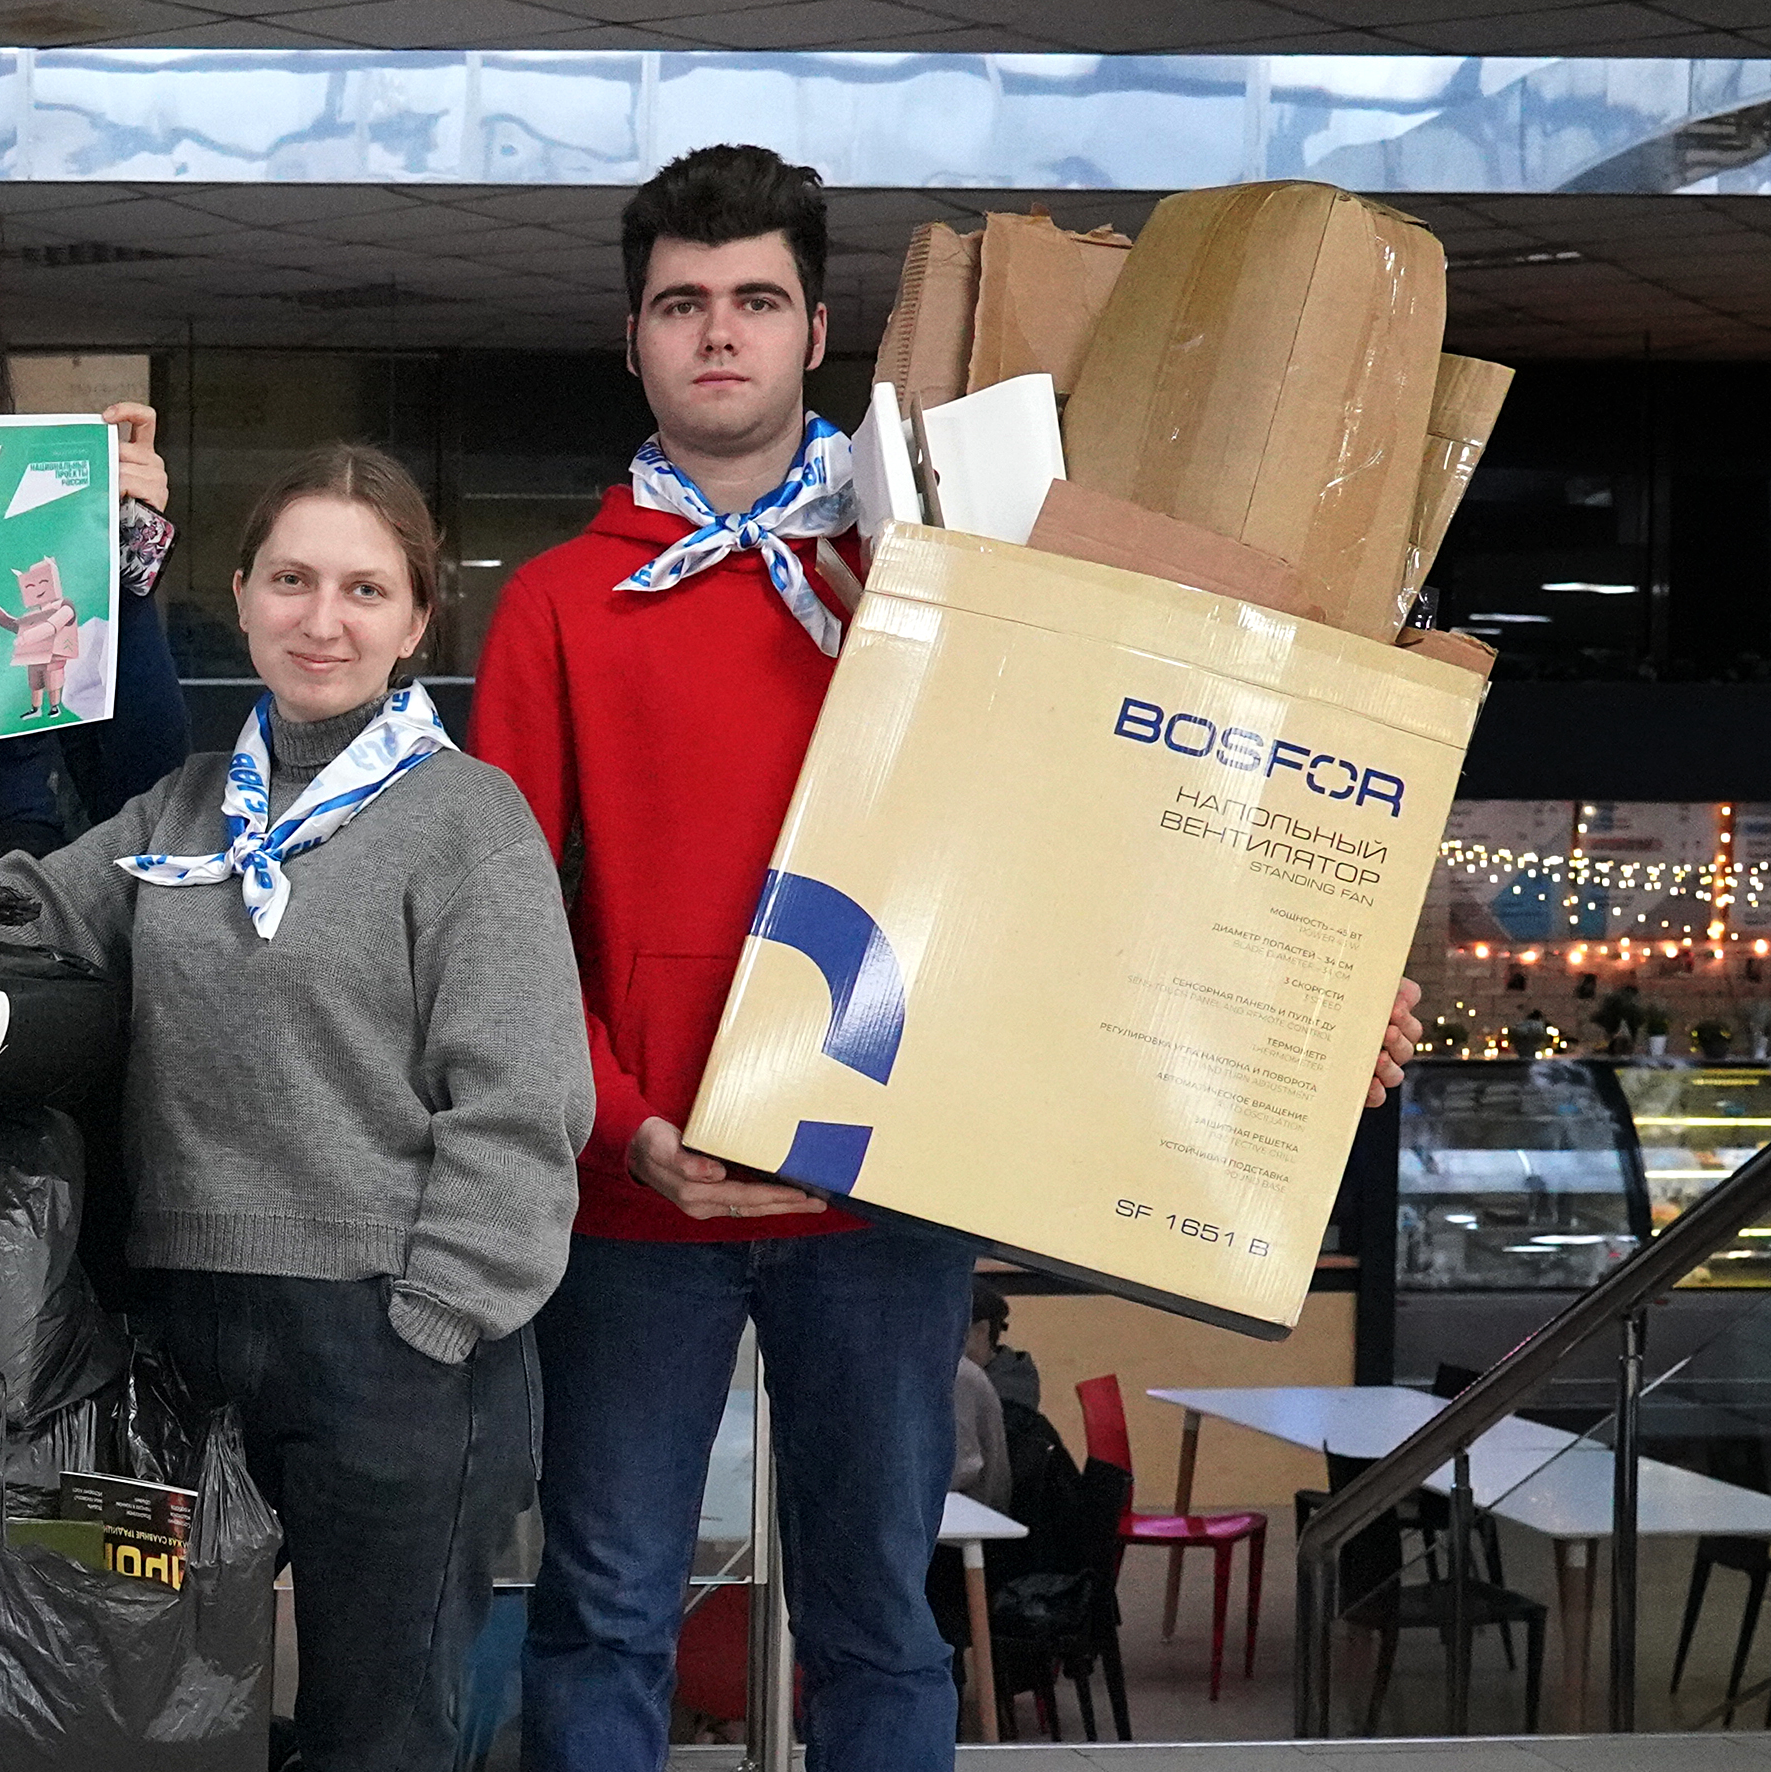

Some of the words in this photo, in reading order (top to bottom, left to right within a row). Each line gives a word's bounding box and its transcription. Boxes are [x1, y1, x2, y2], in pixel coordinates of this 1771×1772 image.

[1113, 696, 1408, 816] BOSFOR
[1174, 783, 1388, 863] НАПОЛЬНЫЙ
[1159, 809, 1381, 891] ВЕНТИЛЯТОР
[1248, 860, 1336, 895] STANDING
[1339, 887, 1374, 907] FAN
[1211, 921, 1261, 944] ДИАМЕТР
[1260, 936, 1317, 960] ЛОПАСТЕЙ
[1323, 955, 1337, 966] 34
[1268, 906, 1329, 932] МОЩНОСТЬ
[1348, 930, 1363, 941] ВТ
[1170, 976, 1234, 1002] СЕНСОРНАЯ
[1234, 994, 1277, 1014] ПАНЕЛЬ
[1277, 1007, 1286, 1017] И
[1320, 1020, 1337, 1034] ДУ
[1283, 975, 1291, 985] 3
[1289, 977, 1346, 1002] СКОРОСТИ
[1098, 1021, 1172, 1050] РЕГУЛИРОВКА
[1200, 1051, 1251, 1073] НАКЛОНА
[1252, 1066, 1261, 1076] И
[1260, 1069, 1318, 1093] ПОВОРОТА
[1250, 1099, 1309, 1124] ВРАЩЕНИЕ
[1251, 1132, 1300, 1154] РЕШЕТКА
[1227, 1158, 1290, 1185] ПОДСТАВКА
[1114, 1196, 1154, 1223] SF
[1162, 1211, 1236, 1248] 1651
[1248, 1237, 1271, 1259] B
